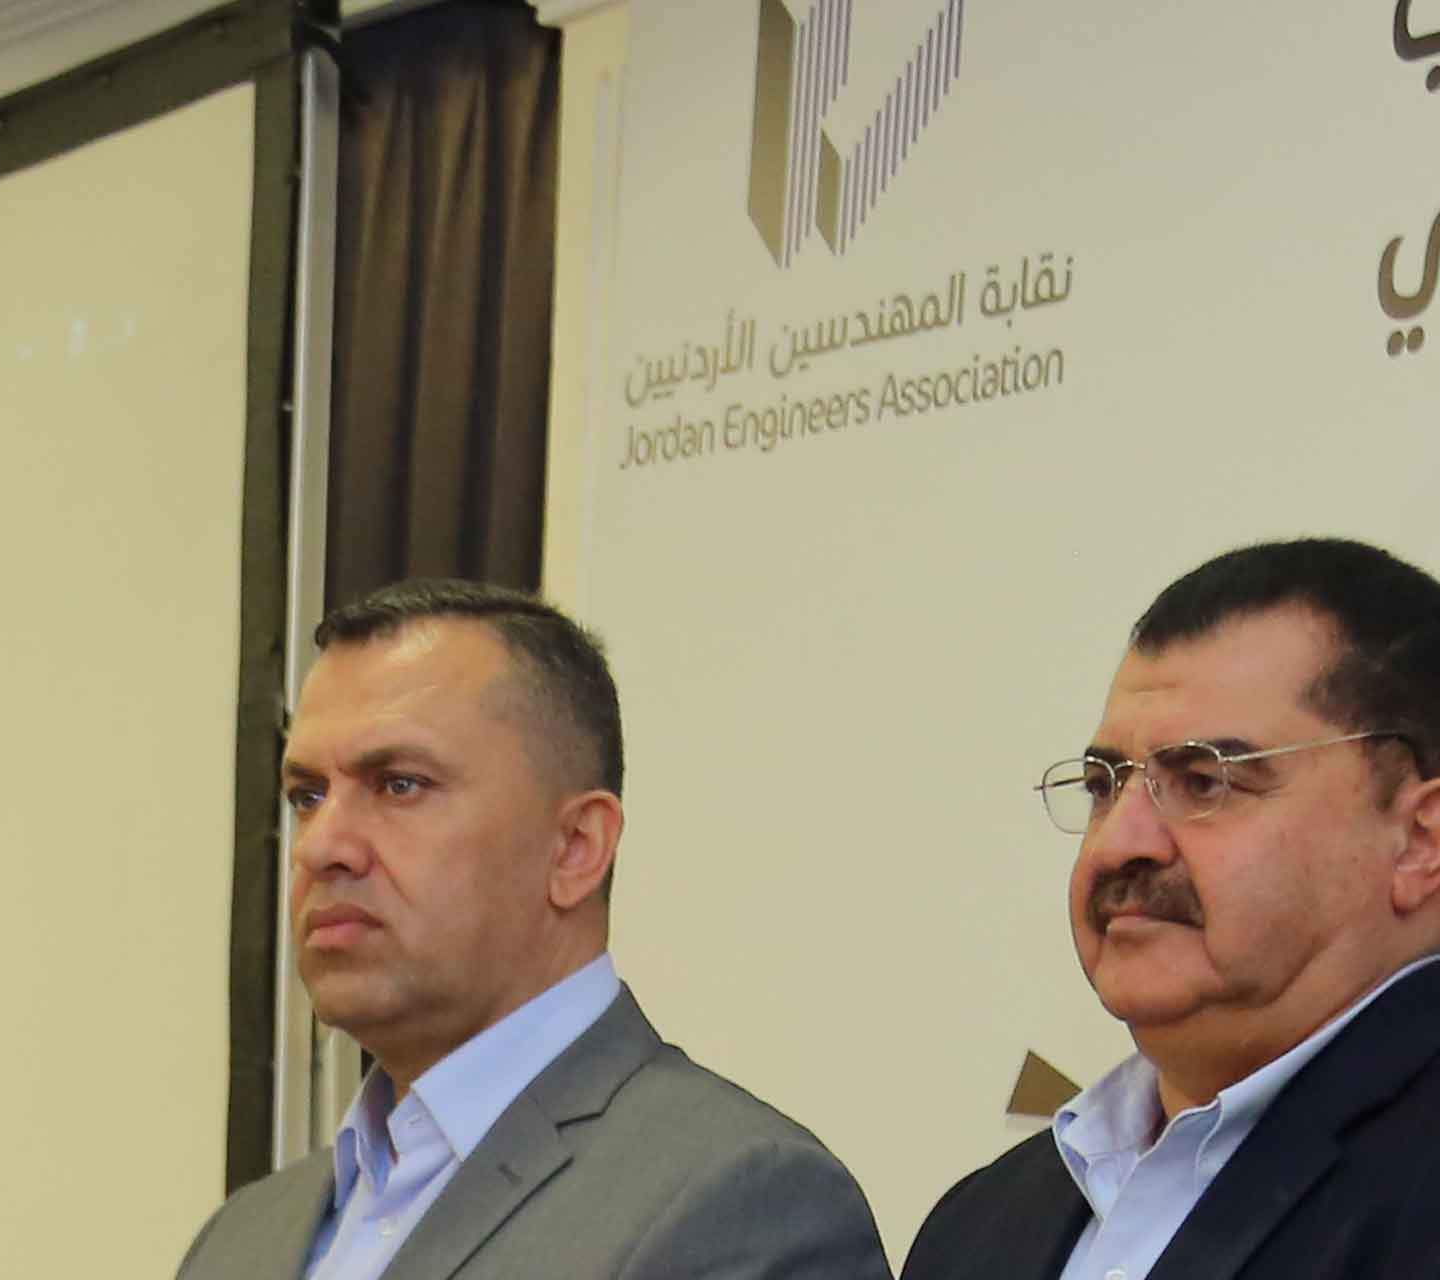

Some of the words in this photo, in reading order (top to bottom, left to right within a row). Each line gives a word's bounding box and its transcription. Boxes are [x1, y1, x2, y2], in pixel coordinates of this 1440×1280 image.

[768, 271, 966, 378] المهندسين
[979, 252, 1073, 327] نقابة
[619, 417, 714, 470] Jordan
[723, 389, 871, 452] Engineers
[876, 345, 1064, 422] Association
[624, 308, 756, 407] الأردنيين
